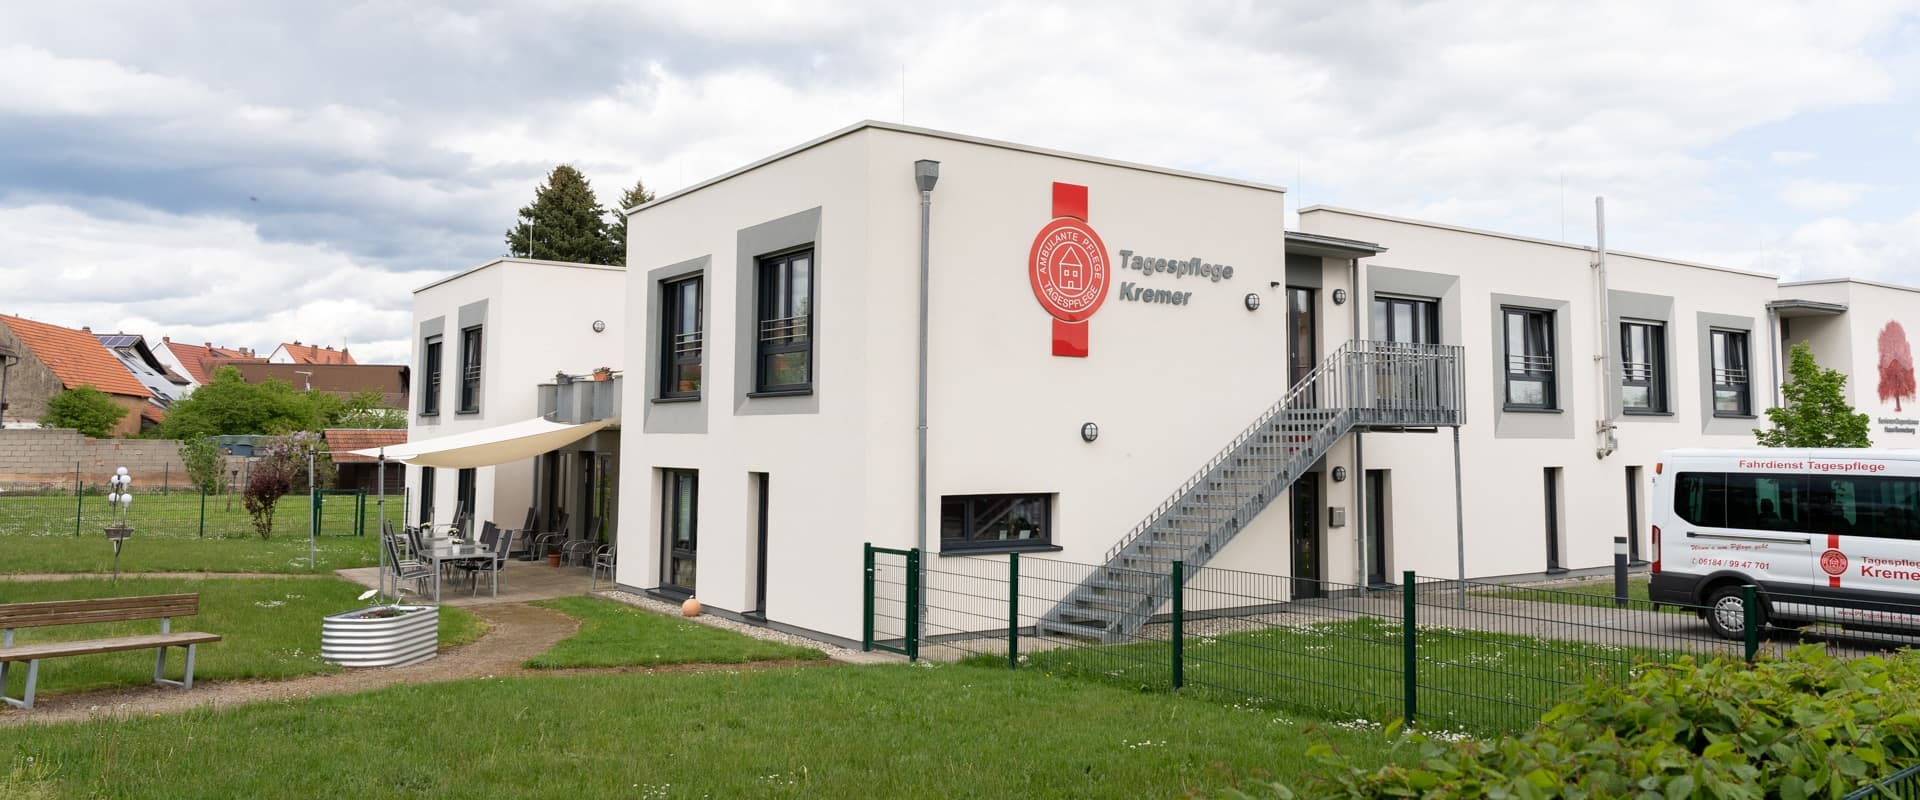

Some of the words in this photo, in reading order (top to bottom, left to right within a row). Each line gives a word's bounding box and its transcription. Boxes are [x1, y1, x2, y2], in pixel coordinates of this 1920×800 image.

[1039, 231, 1079, 274] AMBULANTE
[1081, 238, 1102, 280] PFLEGE
[1119, 249, 1234, 283] Tagespflege
[1044, 280, 1098, 309] TAGESPFLEGE
[1119, 281, 1192, 306] Kremer
[1738, 459, 1804, 470] Fahrdienst
[1807, 461, 1886, 473] Tagespflege
[1729, 560, 1739, 568] 99
[1741, 561, 1752, 569] 47
[1755, 562, 1770, 570] 701
